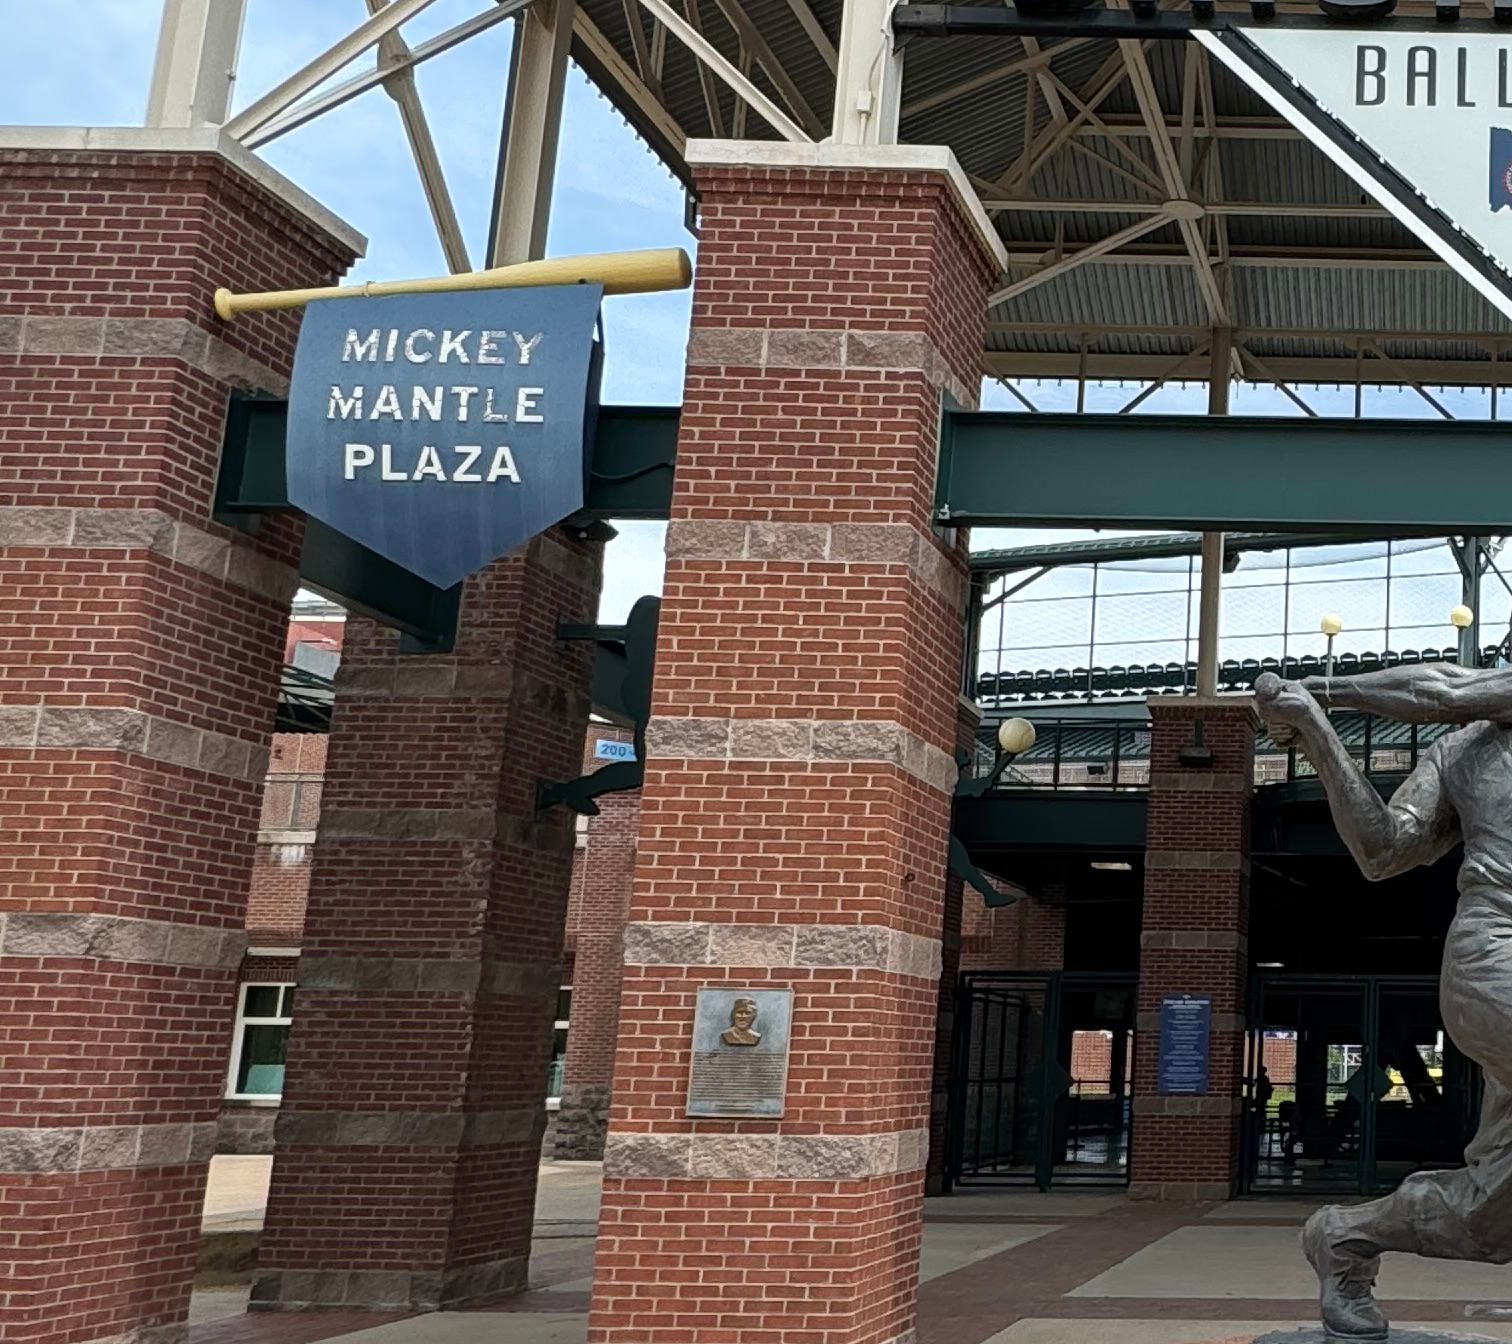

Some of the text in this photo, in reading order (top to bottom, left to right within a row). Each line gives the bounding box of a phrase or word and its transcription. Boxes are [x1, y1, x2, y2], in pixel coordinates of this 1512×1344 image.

[341, 327, 545, 366] MICKEY
[326, 384, 546, 424] MANTLE
[343, 443, 522, 484] PLAZA
[600, 743, 627, 758] 200
